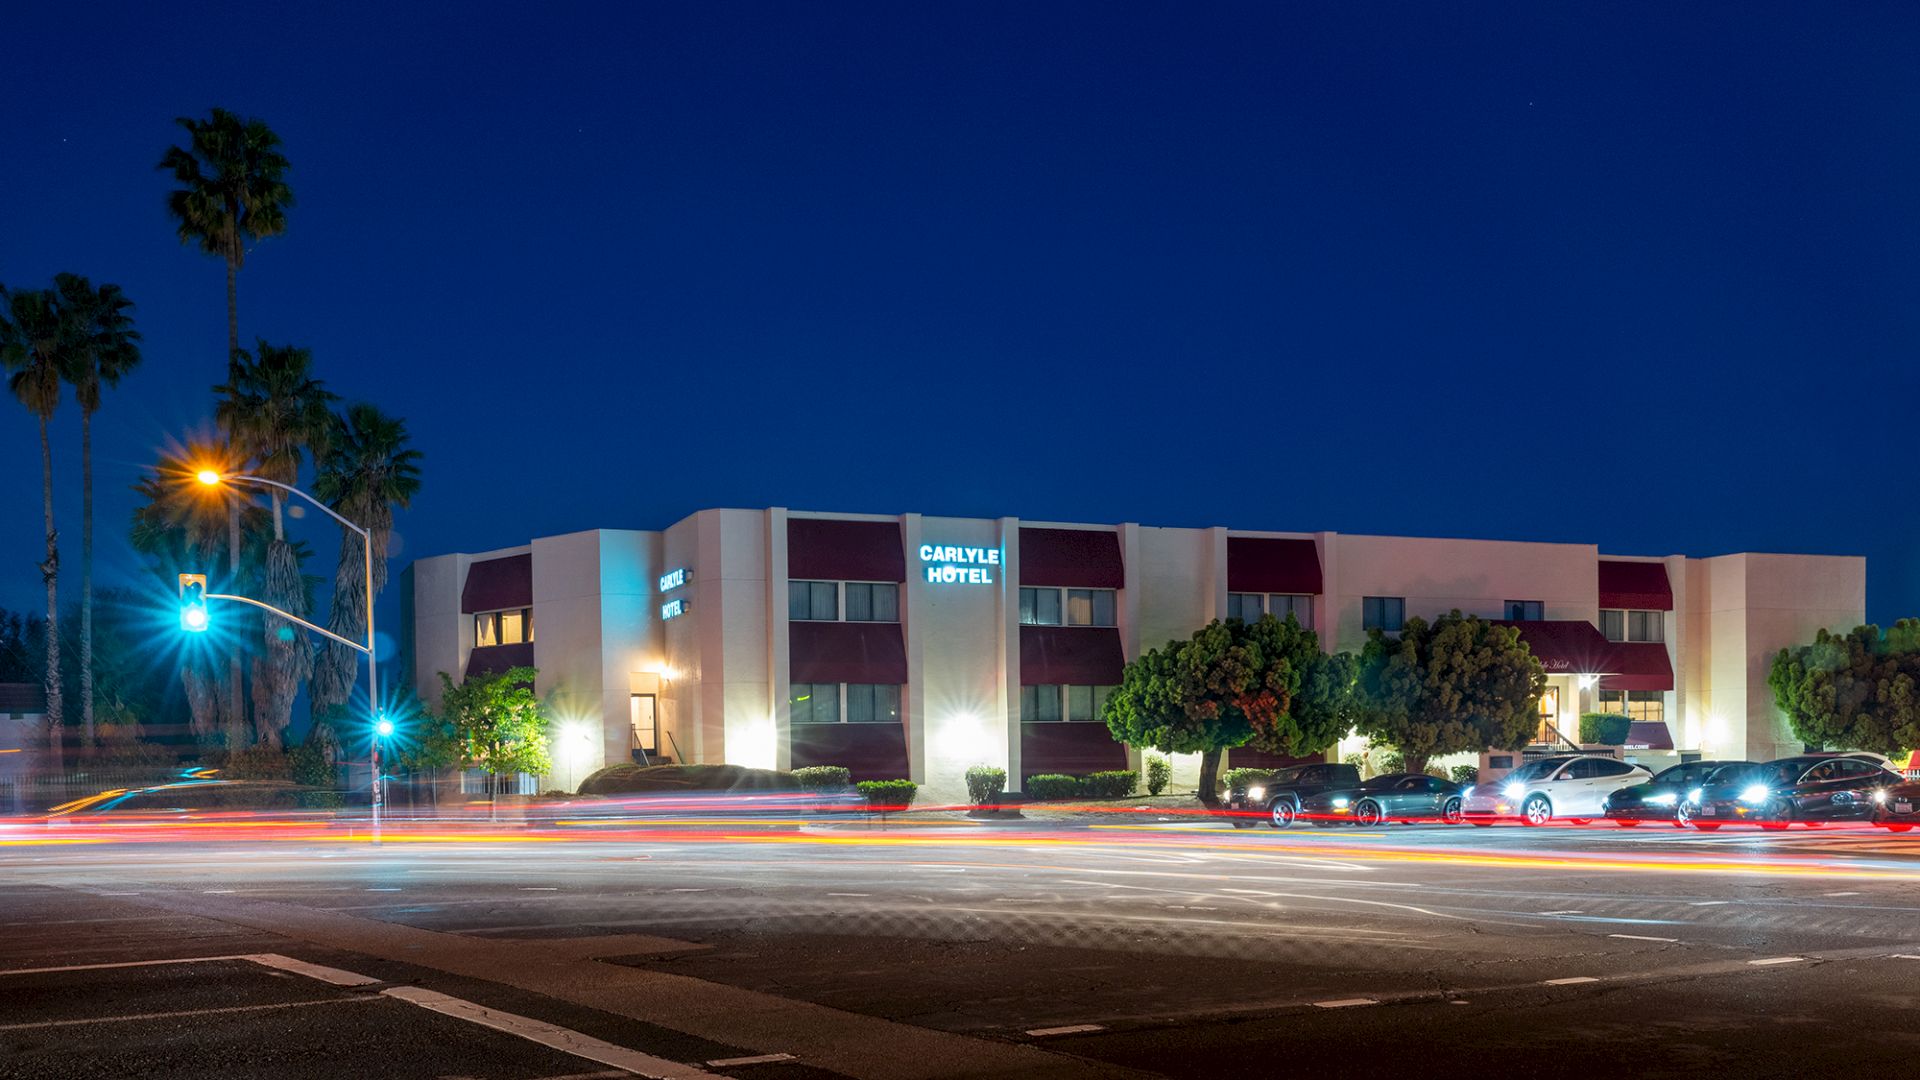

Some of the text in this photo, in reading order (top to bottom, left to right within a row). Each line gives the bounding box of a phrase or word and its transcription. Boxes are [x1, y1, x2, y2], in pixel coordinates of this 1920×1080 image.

[920, 545, 999, 564] CARLYLE
[660, 569, 684, 592] CARLYLE
[928, 566, 992, 583] HOTEL
[662, 600, 682, 620] HOTEL
